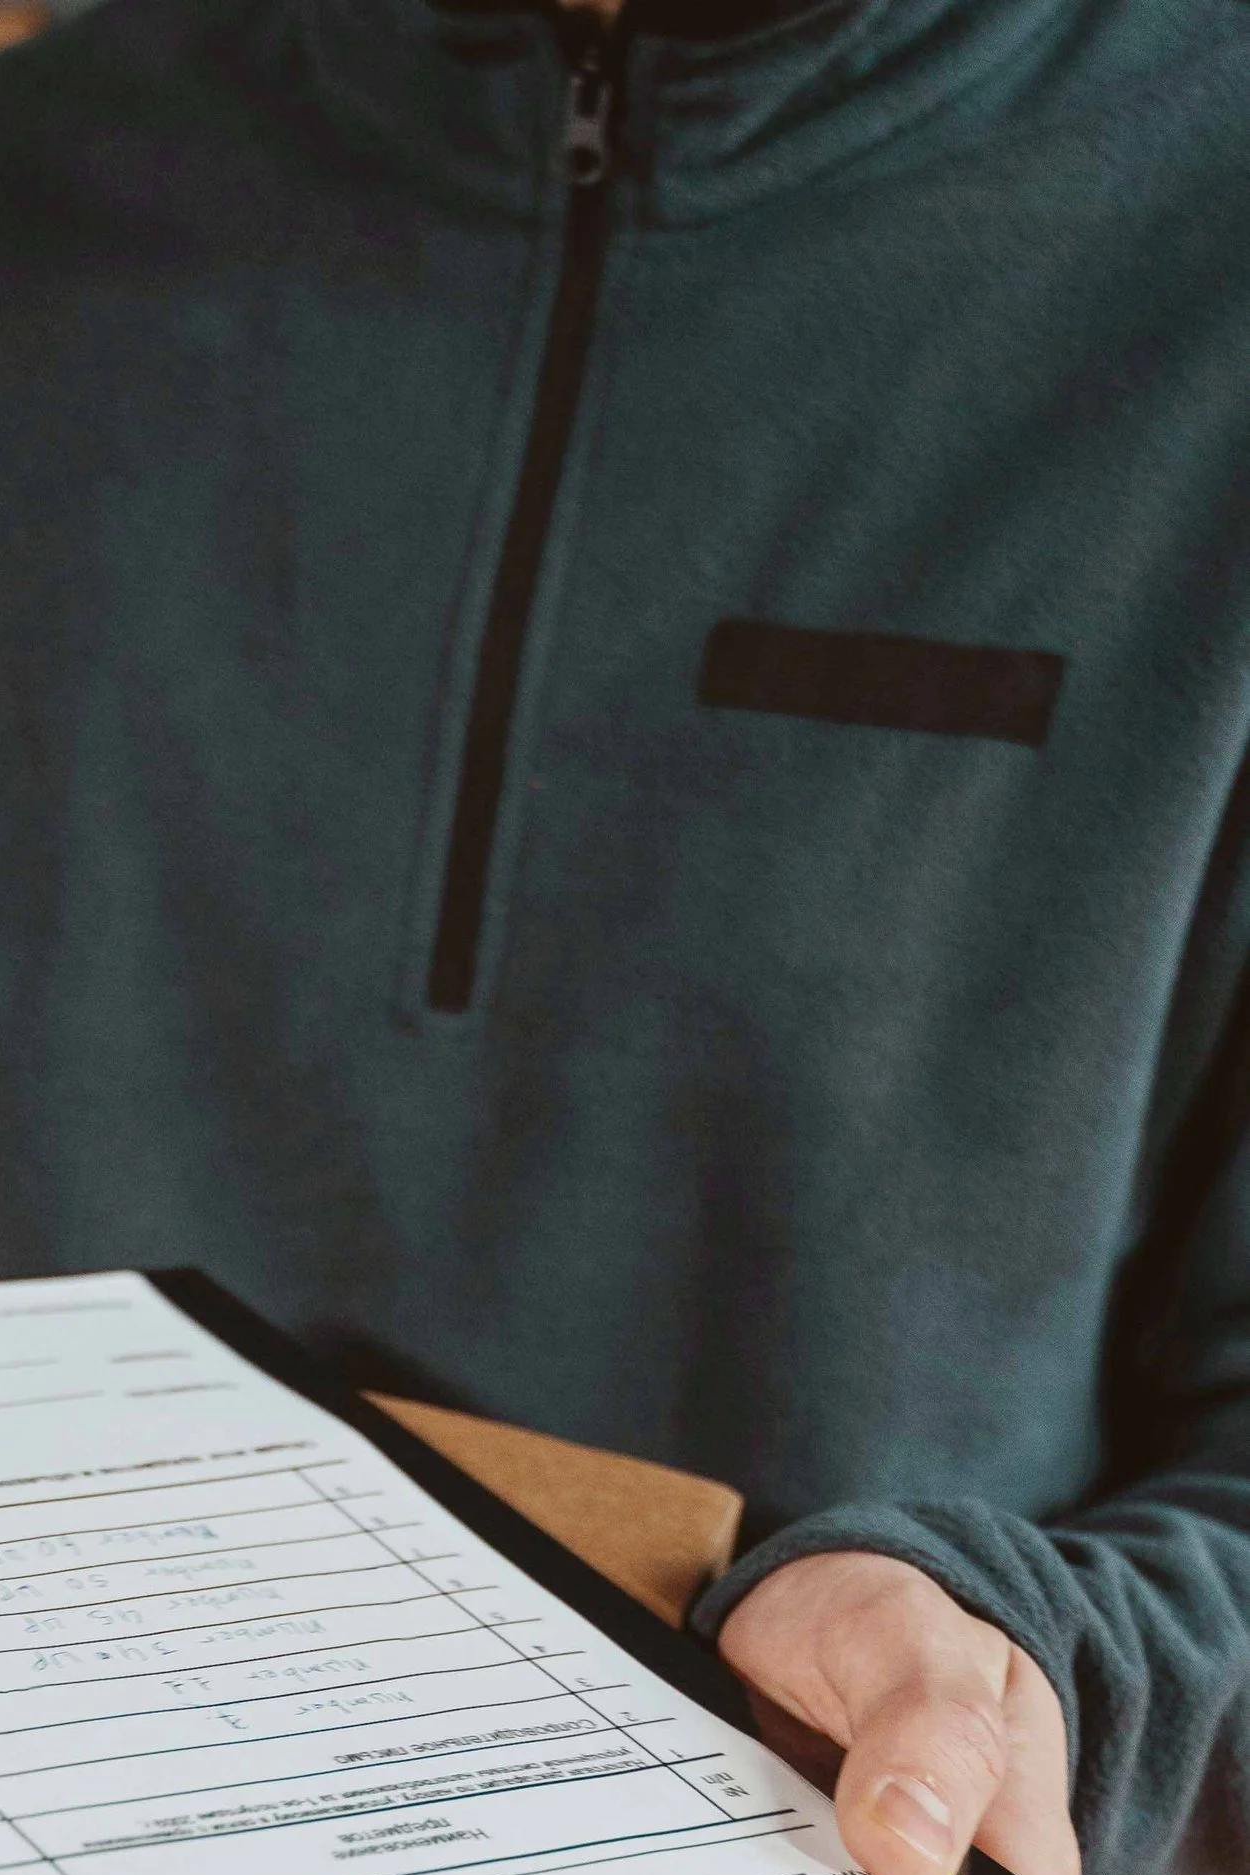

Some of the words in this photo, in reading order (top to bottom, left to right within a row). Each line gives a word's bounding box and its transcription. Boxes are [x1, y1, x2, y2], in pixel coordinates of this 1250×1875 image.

[410, 1718, 597, 1754] Сопроводительное
[333, 1746, 409, 1765] письмо
[332, 1828, 490, 1860] Наименование
[338, 1818, 452, 1844] предметов
